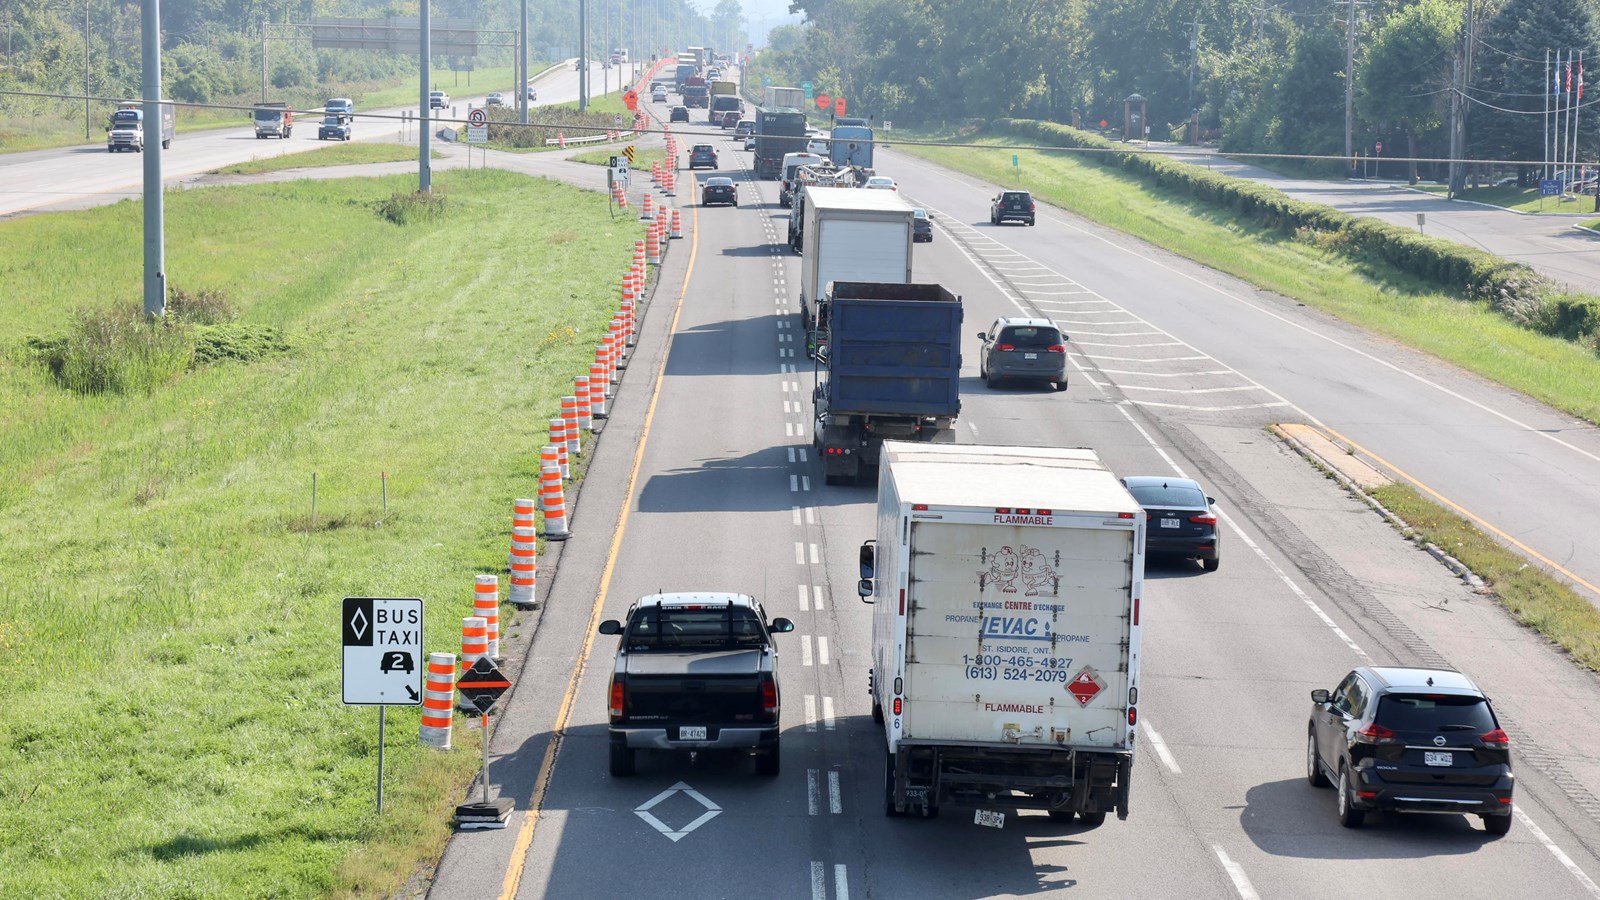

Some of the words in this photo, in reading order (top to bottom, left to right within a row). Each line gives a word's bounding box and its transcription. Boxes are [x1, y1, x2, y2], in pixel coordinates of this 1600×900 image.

[993, 514, 1053, 526] FLAMMABLE
[972, 601, 1003, 610] EXHANGE
[1004, 601, 1032, 611] CENTRE
[377, 609, 418, 624] BUS
[945, 615, 979, 624] PROPANE
[980, 616, 1045, 640] LEVAC
[377, 630, 418, 645] TAXI
[1056, 634, 1090, 643] PROPANE
[982, 645, 994, 653] ST.
[996, 646, 1030, 654] ISIDORE,
[1033, 647, 1051, 655] ONT.
[391, 653, 404, 669] 2
[962, 654, 1073, 669] 1-800-465-4927
[965, 666, 998, 681] (613)
[1003, 668, 1067, 682] 524-2079
[985, 703, 1044, 714] FLAMMABLE
[894, 718, 901, 729] 6
